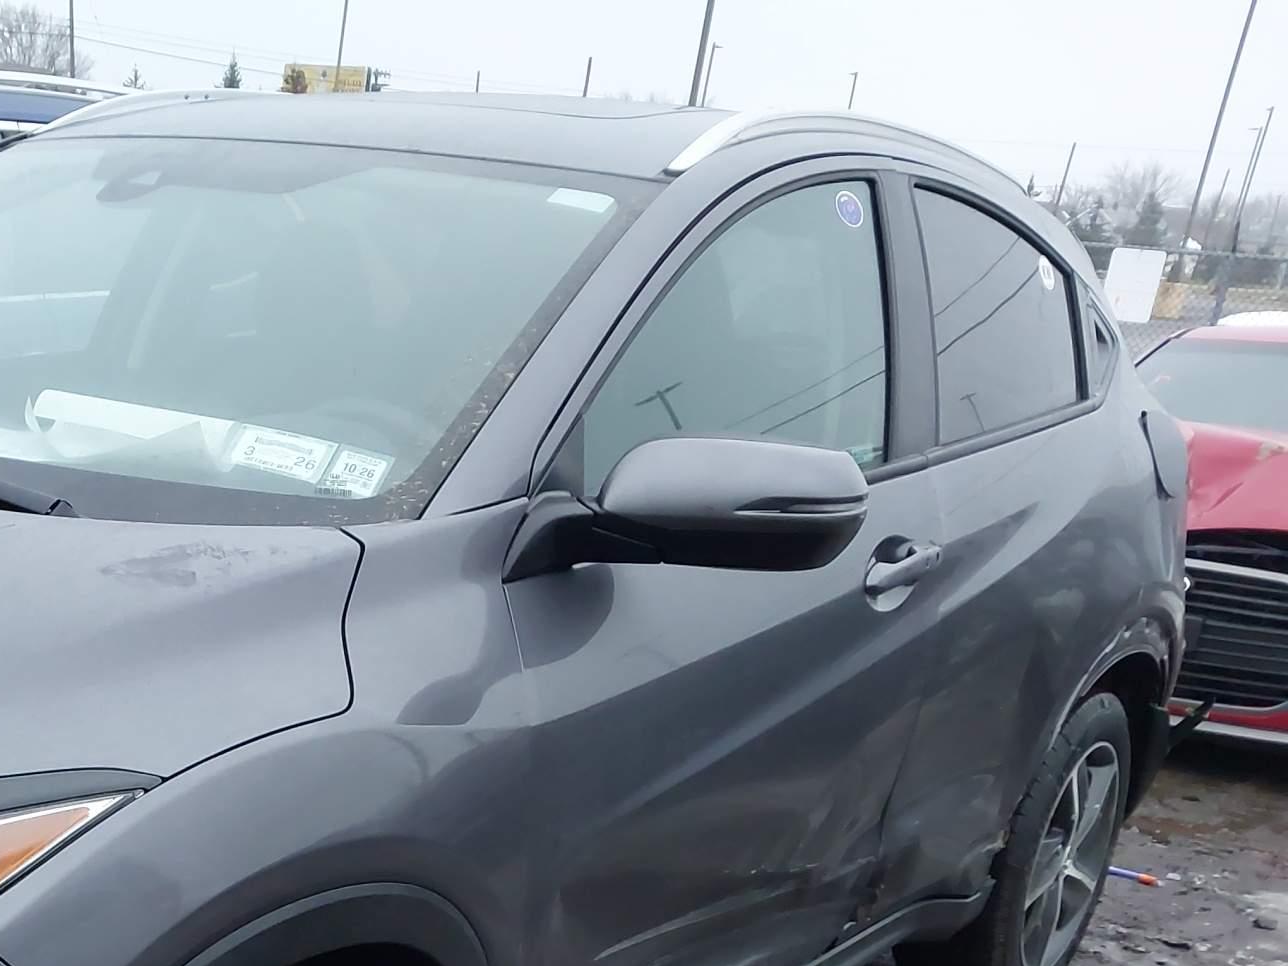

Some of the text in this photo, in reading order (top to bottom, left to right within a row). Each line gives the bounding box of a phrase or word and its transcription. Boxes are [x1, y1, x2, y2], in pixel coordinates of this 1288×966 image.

[243, 445, 256, 457] 3
[293, 456, 317, 471] 26
[343, 461, 377, 480] 10 26
